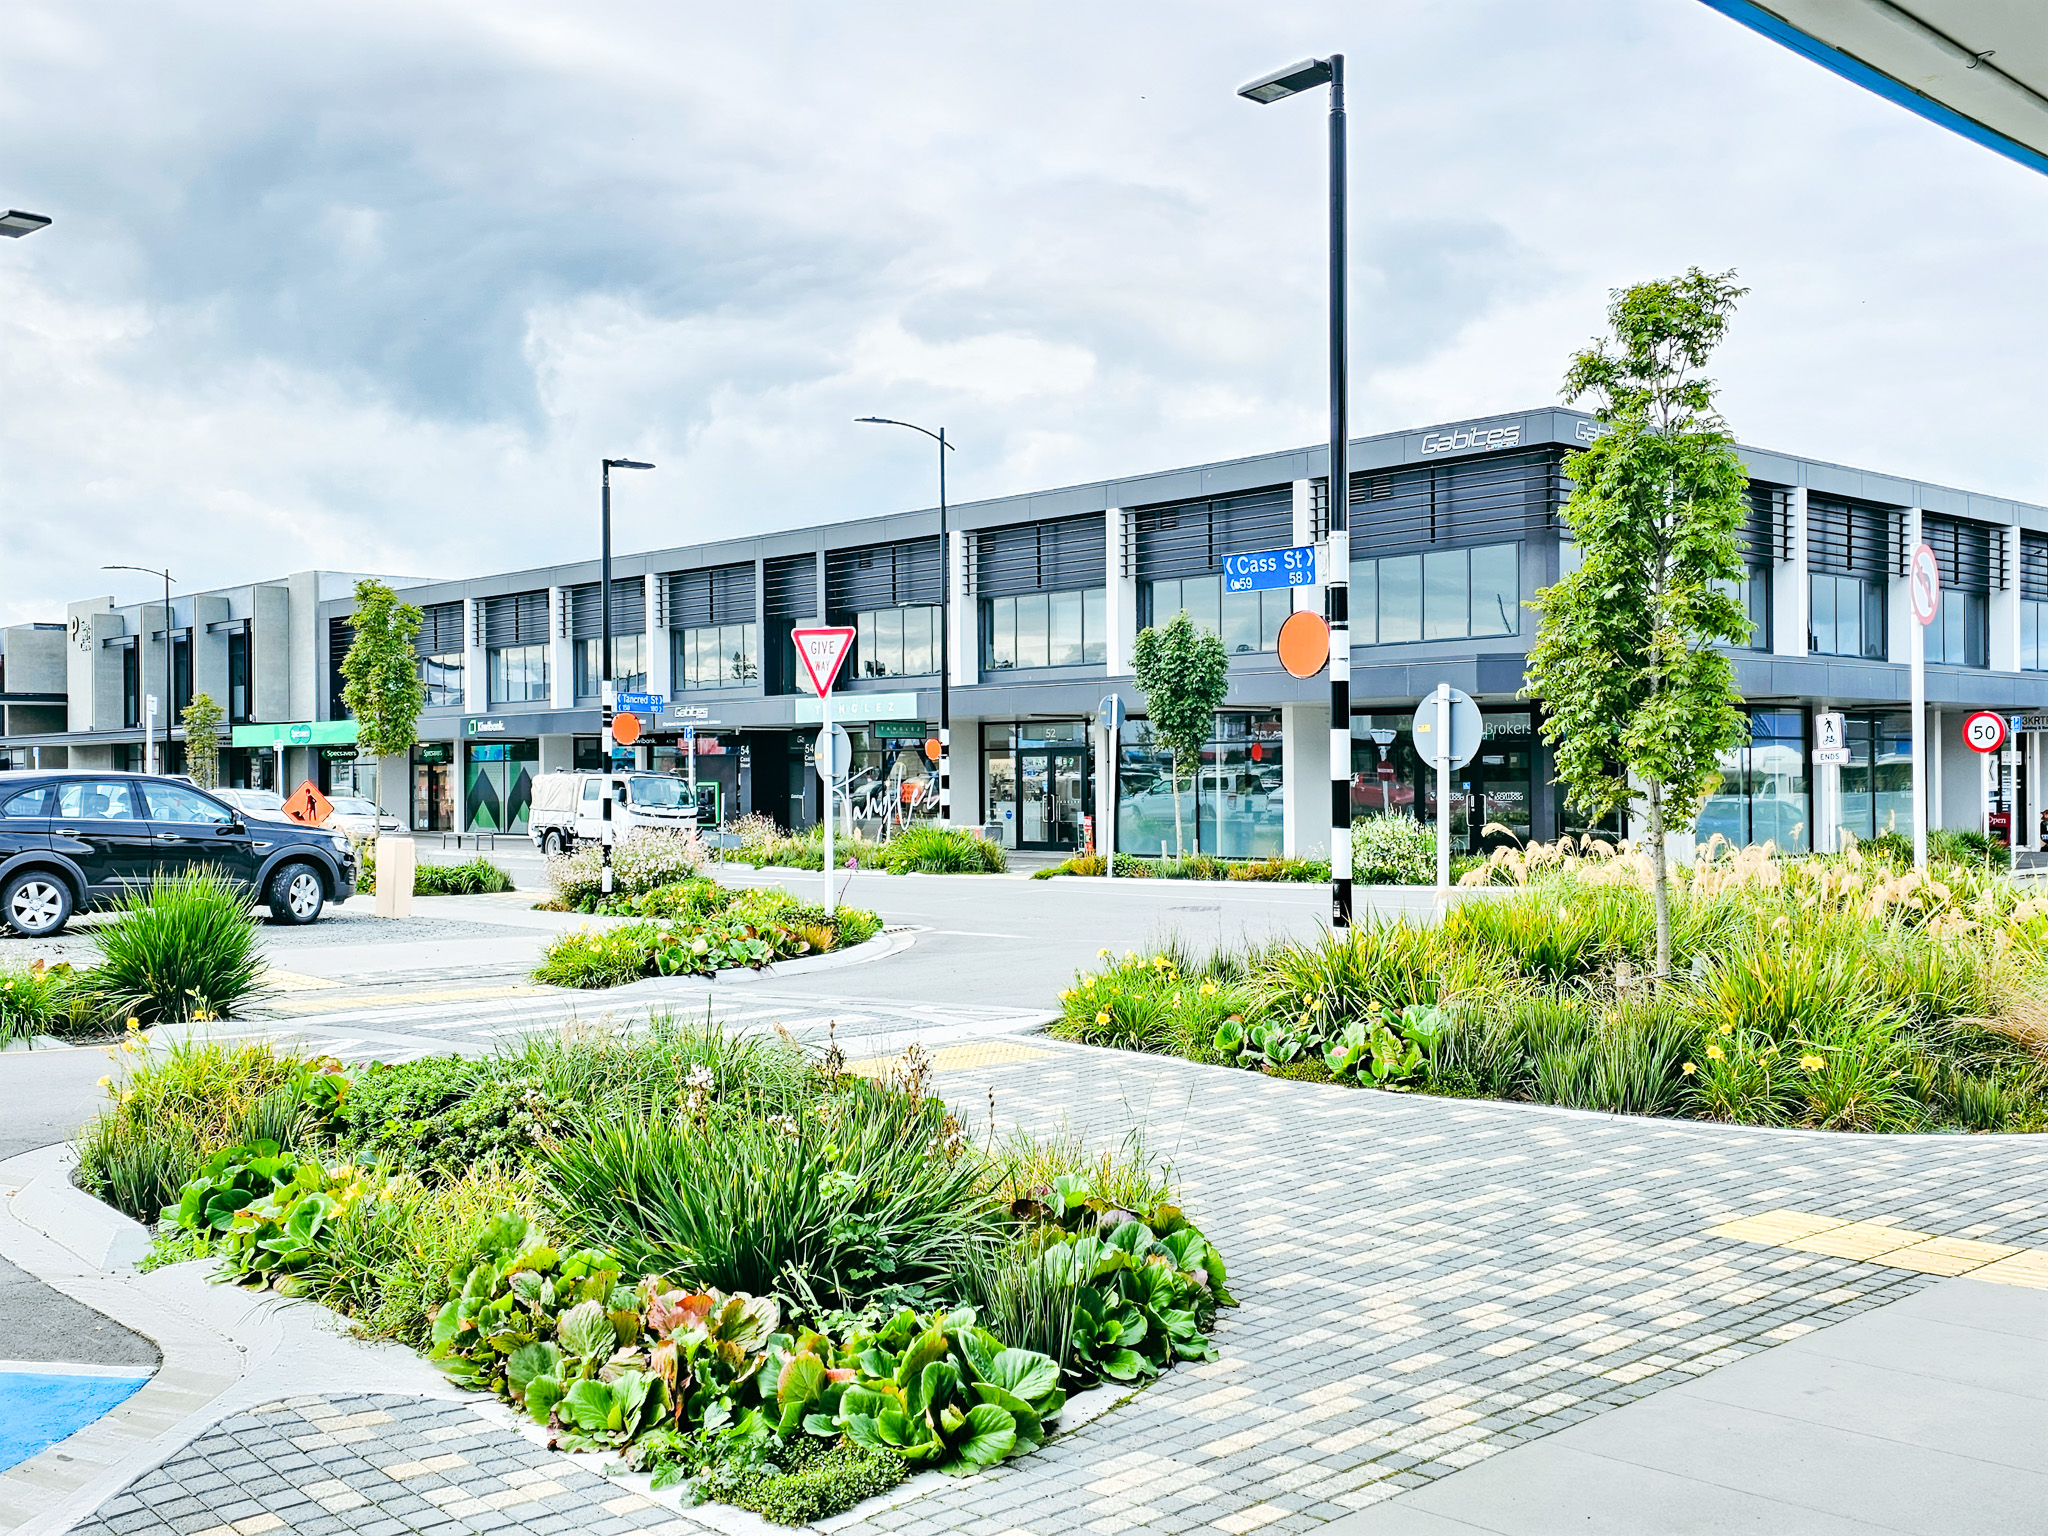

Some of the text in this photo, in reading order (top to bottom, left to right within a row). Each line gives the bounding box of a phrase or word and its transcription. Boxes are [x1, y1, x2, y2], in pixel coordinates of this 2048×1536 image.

[1421, 425, 1521, 455] Gabites
[1237, 551, 1302, 575] Cass St
[1239, 577, 1253, 589] 59
[1289, 571, 1303, 584] 58
[811, 641, 835, 655] GIVE
[815, 661, 831, 672] WAY
[622, 694, 659, 705] Tancred St
[815, 702, 895, 715] TNGLEZ
[1045, 728, 1056, 738] 52
[1485, 721, 1531, 735] Brokers
[1973, 725, 1996, 740] 50
[326, 750, 357, 758] Specsavers
[740, 745, 750, 755] 54
[804, 743, 815, 754] 54
[1820, 753, 1840, 761] ENDS
